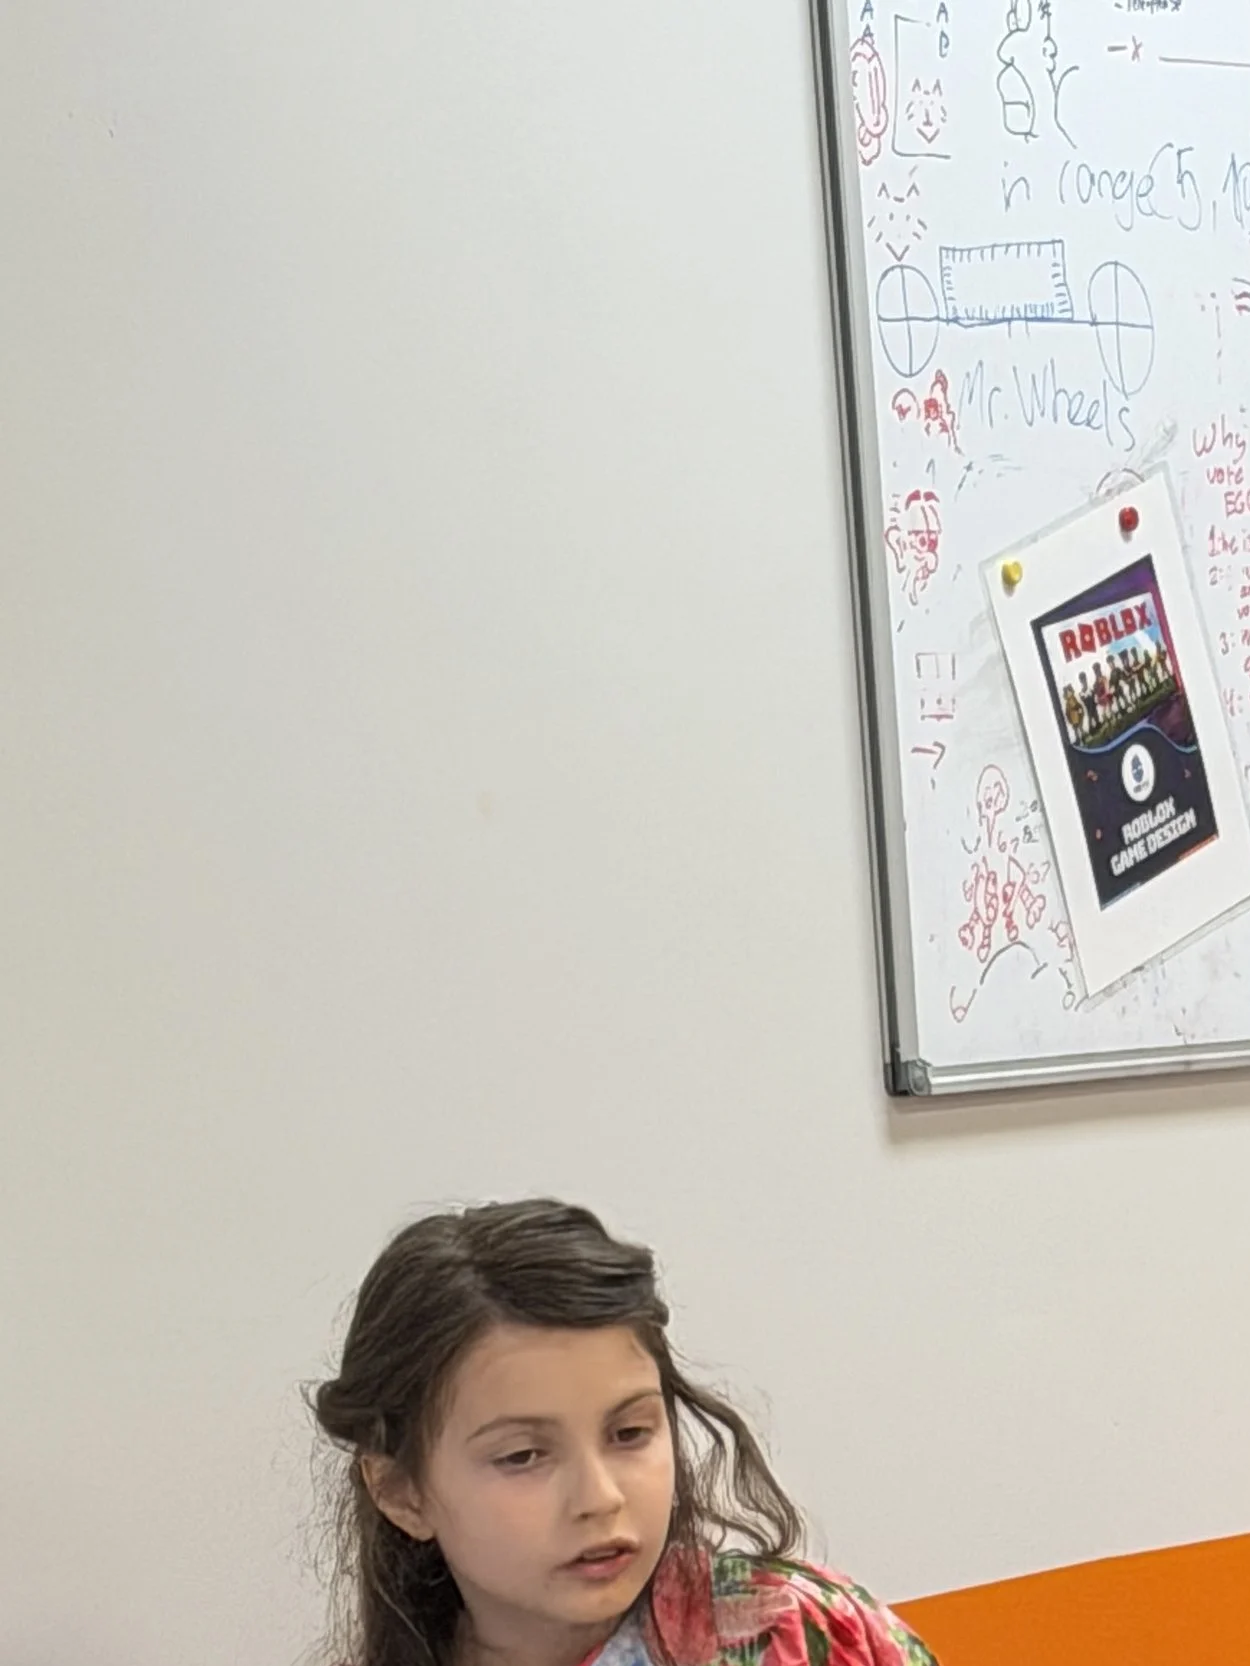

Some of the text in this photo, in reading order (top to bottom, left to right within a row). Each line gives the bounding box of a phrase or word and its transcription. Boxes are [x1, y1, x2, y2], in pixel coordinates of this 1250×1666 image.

[1013, 358, 1137, 451] Wheels
[1193, 413, 1247, 465] Why
[1206, 465, 1244, 486] vote
[1059, 602, 1152, 663] ROBLOX
[1110, 807, 1197, 877] GAME DESIGN
[1121, 795, 1176, 845] ROBLOX
